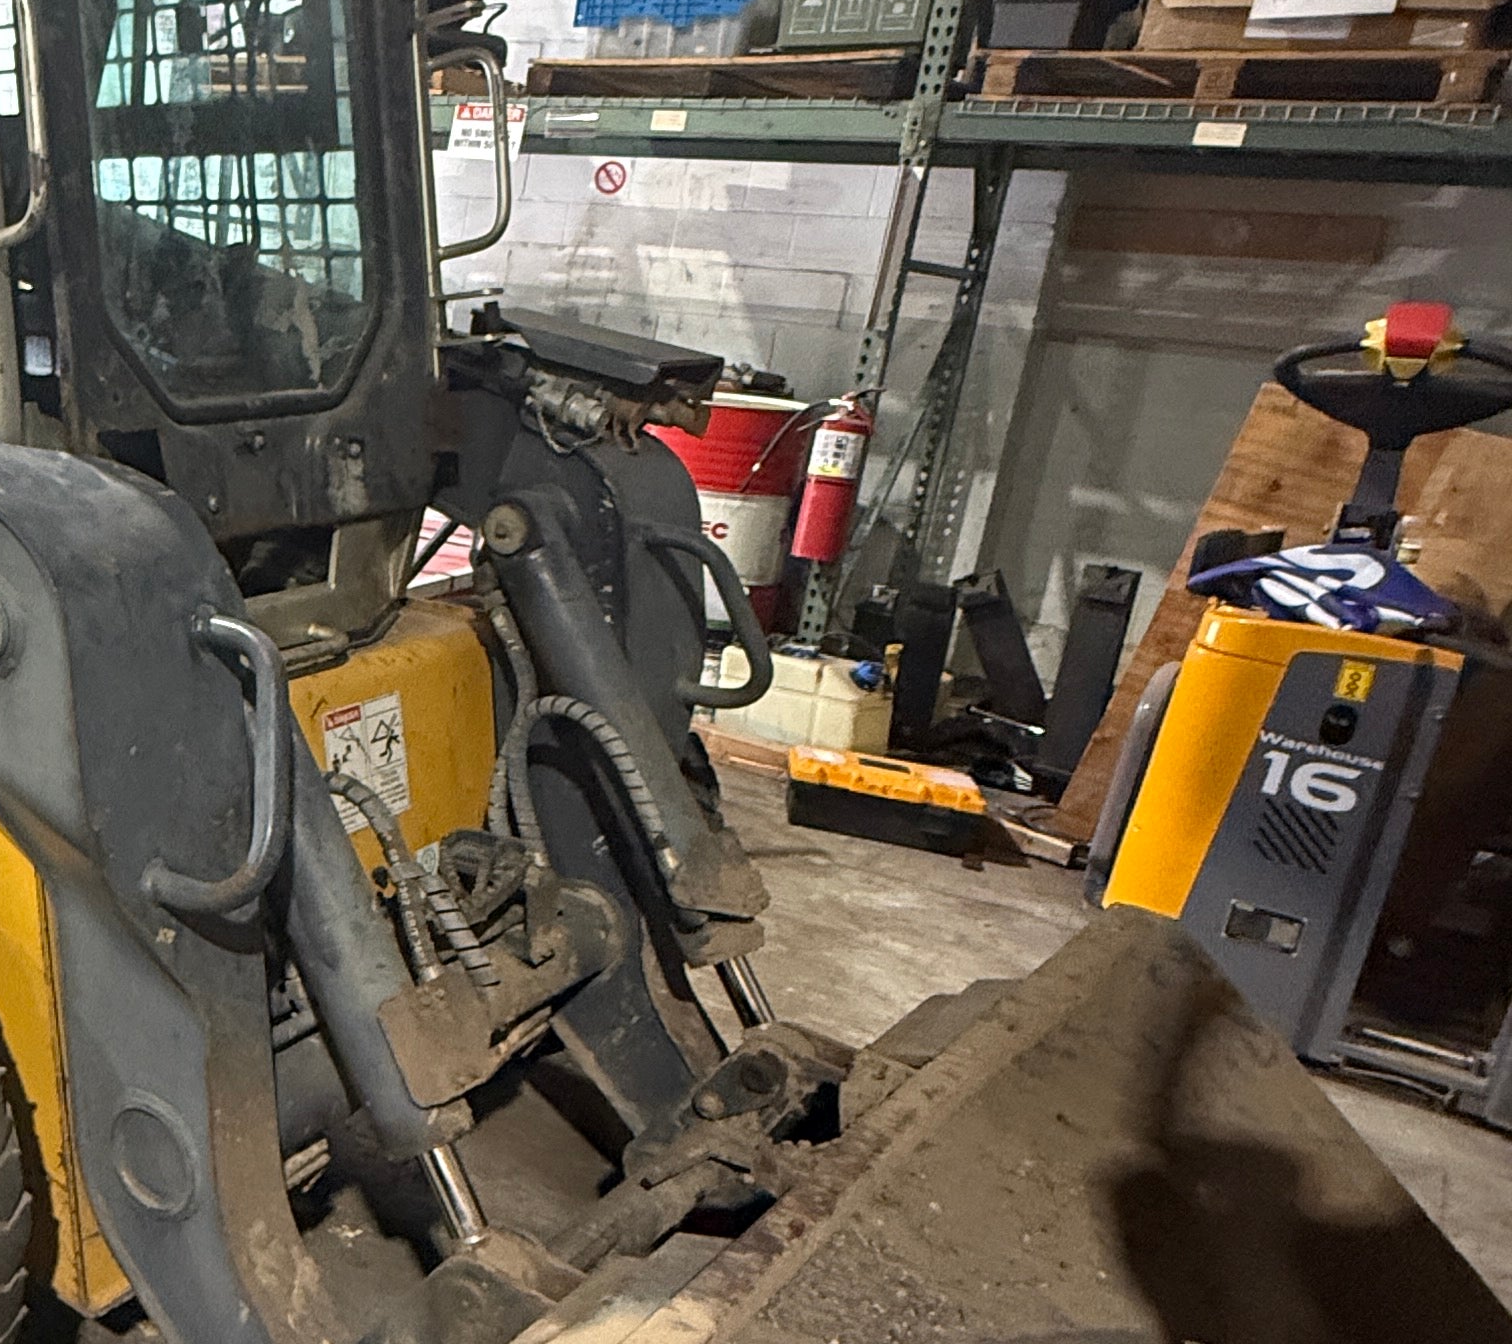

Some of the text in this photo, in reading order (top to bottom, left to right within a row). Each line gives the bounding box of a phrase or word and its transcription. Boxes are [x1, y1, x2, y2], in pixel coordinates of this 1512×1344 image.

[472, 106, 521, 121] DANER
[1259, 729, 1385, 770] Warehouse
[1261, 750, 1363, 811] 16
